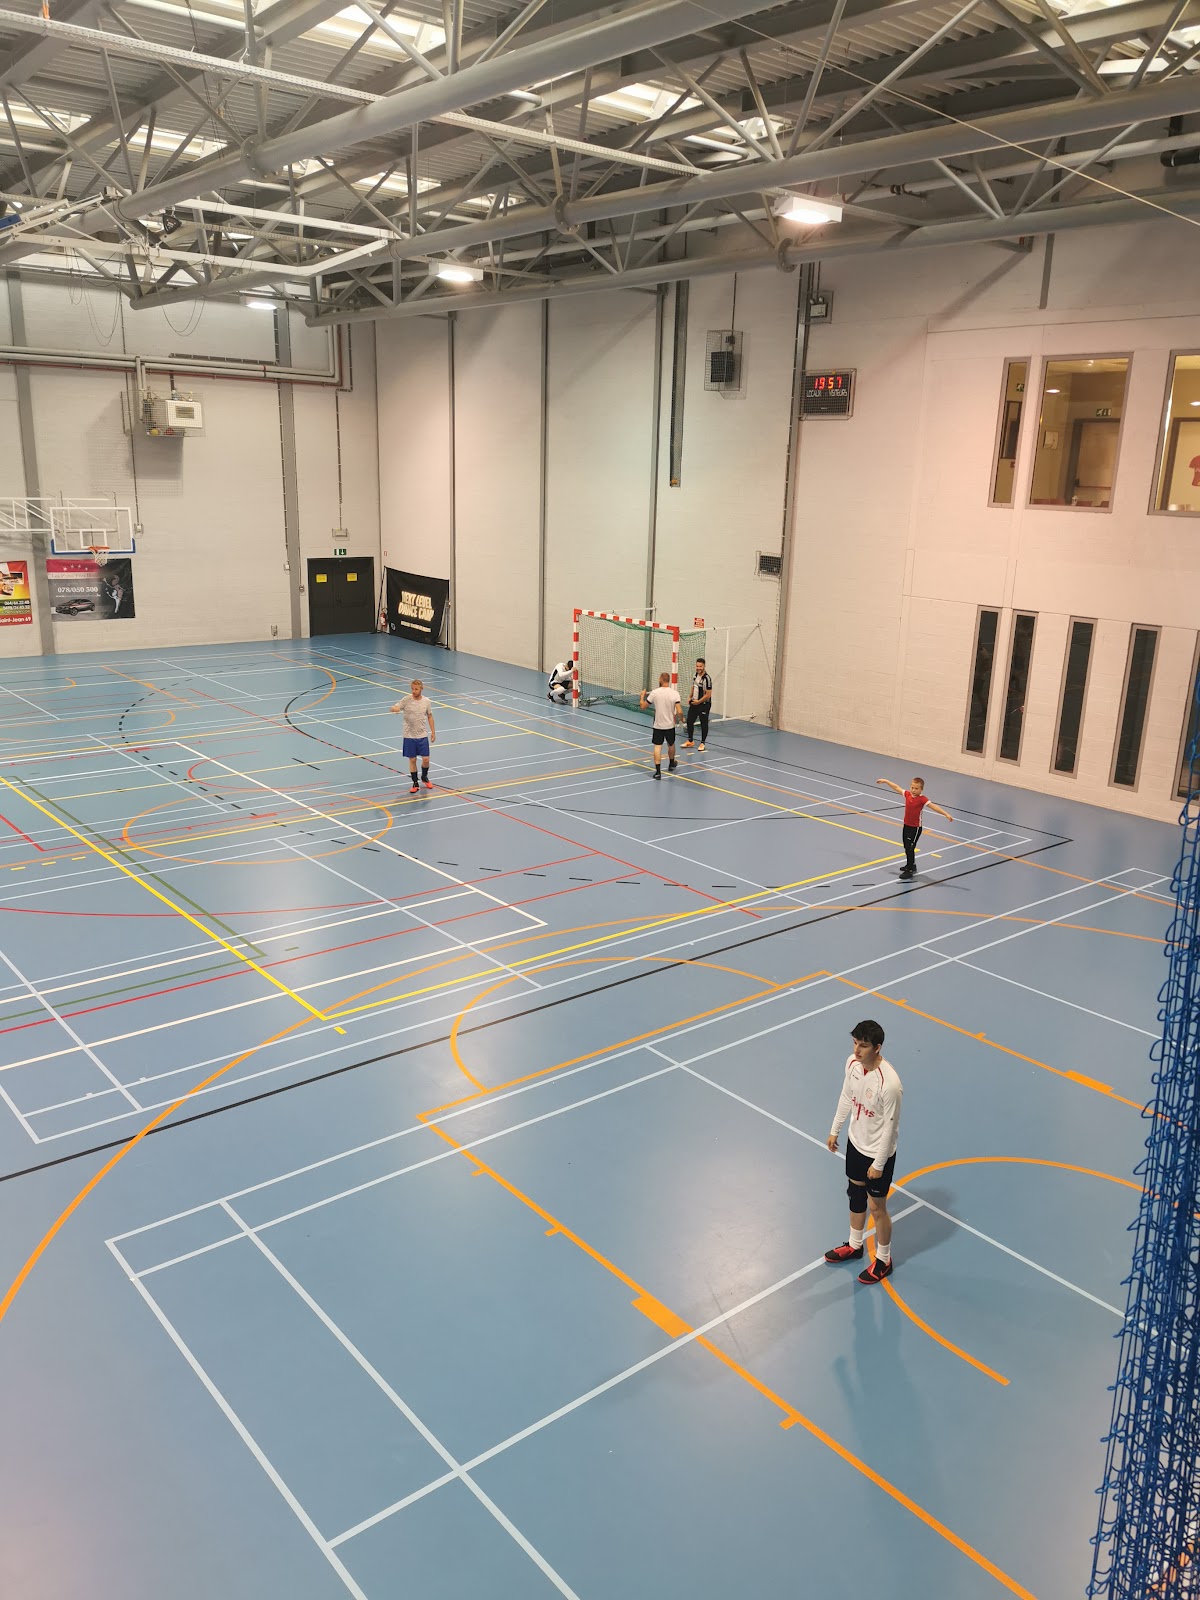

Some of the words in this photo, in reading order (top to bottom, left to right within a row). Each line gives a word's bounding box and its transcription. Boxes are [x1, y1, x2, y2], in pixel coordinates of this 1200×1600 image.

[401, 590, 417, 606] NEXT
[415, 594, 432, 609] LEVEL
[398, 602, 417, 617] DANCE
[418, 607, 434, 621] CAMP
